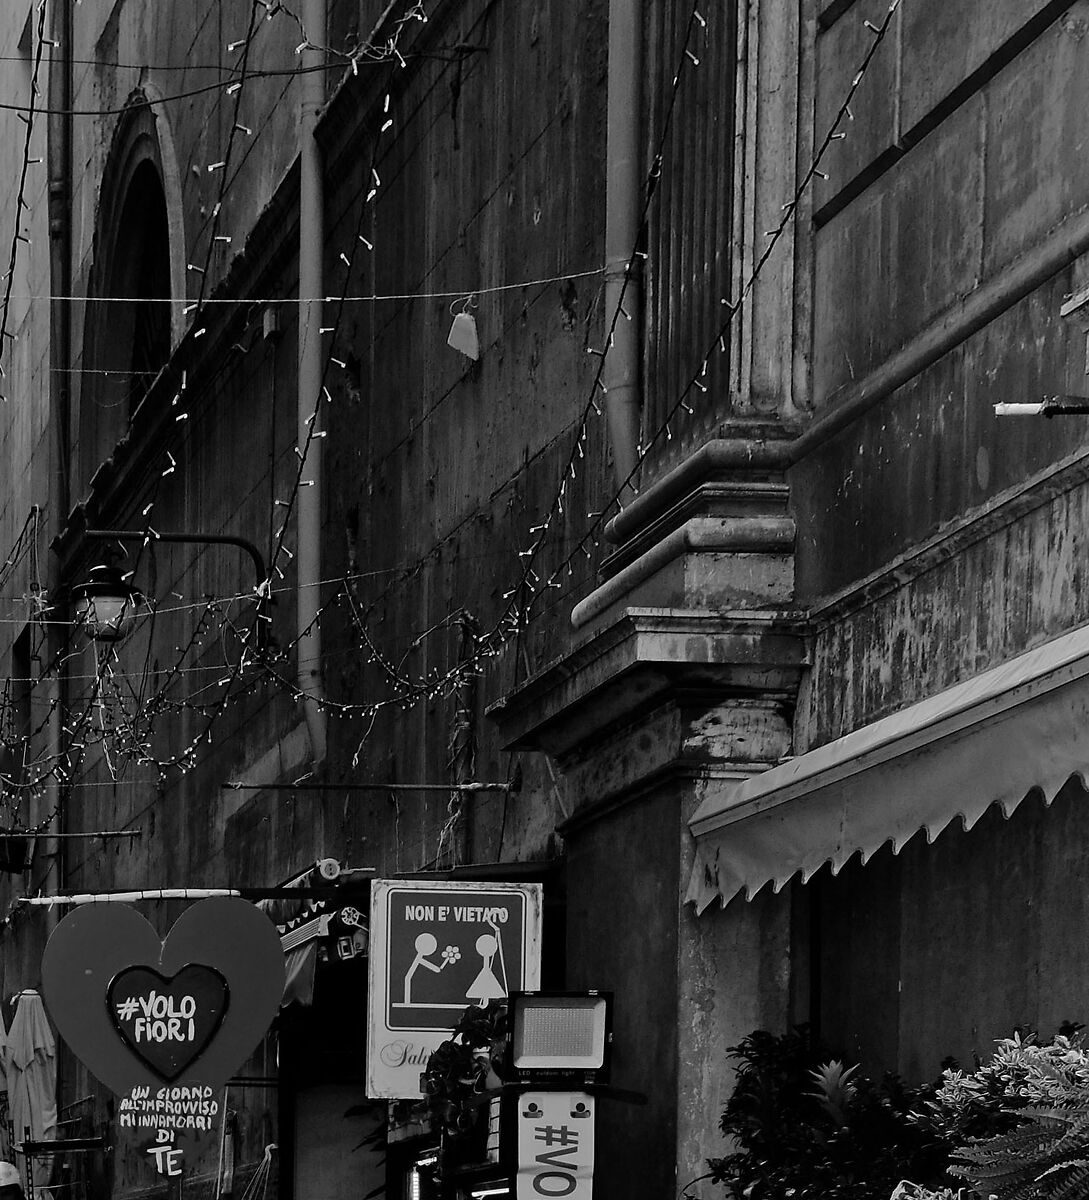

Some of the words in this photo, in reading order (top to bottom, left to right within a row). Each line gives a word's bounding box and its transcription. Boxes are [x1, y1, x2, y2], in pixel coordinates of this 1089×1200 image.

[405, 905, 434, 921] NON
[438, 906, 450, 922] E'
[453, 906, 509, 923] VIETATO
[116, 990, 197, 1021] #VOLO
[131, 1085, 150, 1101] UN
[156, 1085, 213, 1101] GIORNO
[155, 1129, 175, 1143] DI
[146, 1145, 184, 1176] TE
